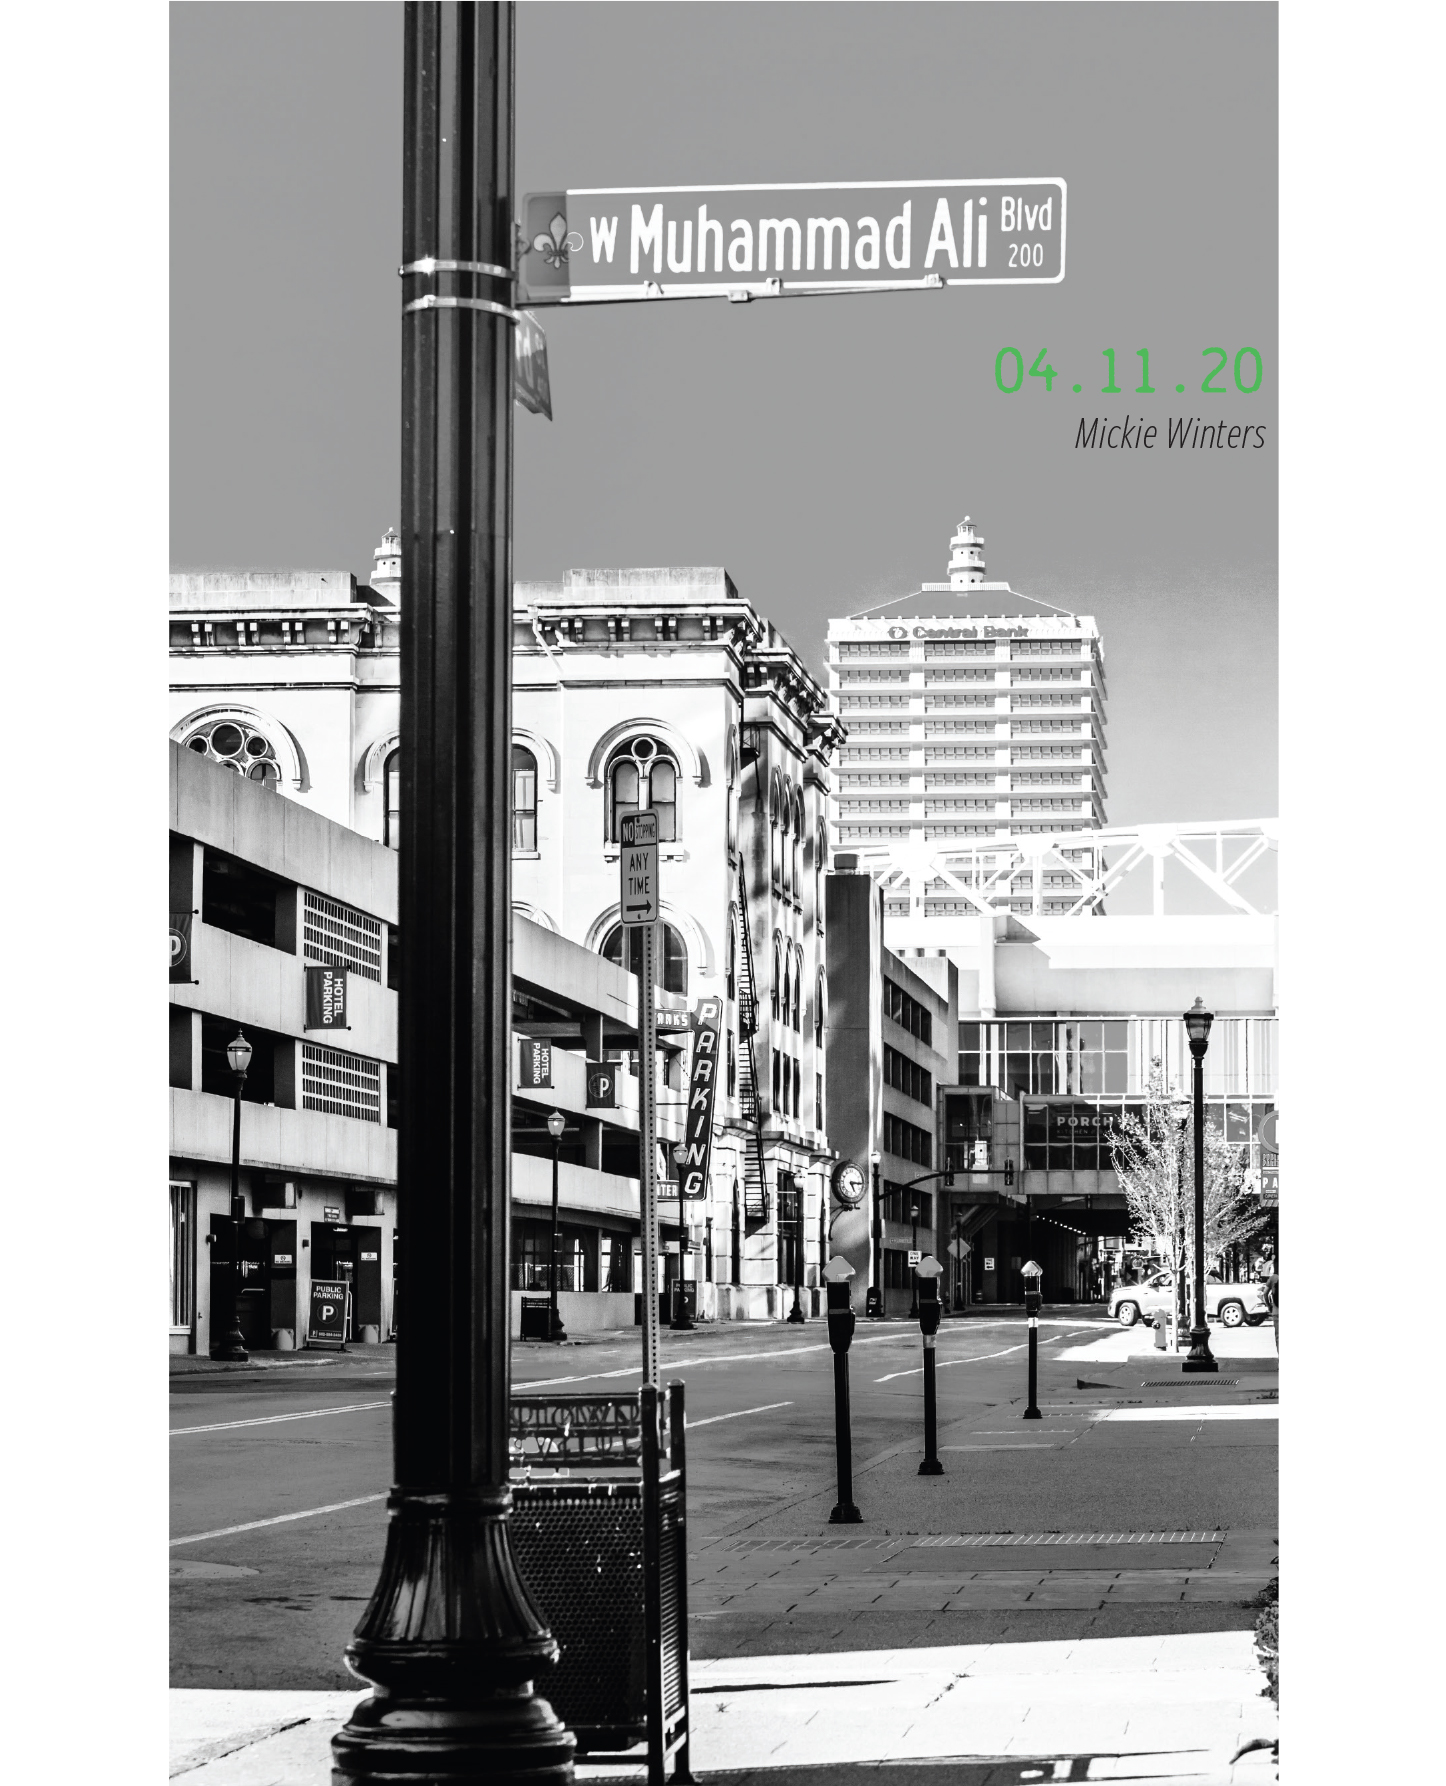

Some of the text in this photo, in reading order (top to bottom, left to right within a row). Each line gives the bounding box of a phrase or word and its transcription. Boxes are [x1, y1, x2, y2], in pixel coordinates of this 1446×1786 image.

[590, 197, 1052, 273] W Muhammad Ali Blvd
[1009, 244, 1043, 268] 200
[912, 626, 1028, 639] Central Bank
[622, 822, 655, 842] NO STOPPING
[630, 852, 649, 872] ANY
[628, 876, 650, 895] TIME
[323, 971, 333, 1024] PARKING
[334, 978, 344, 1016] HOTEL
[655, 1012, 688, 1026] ARKS
[532, 1042, 541, 1085] PARKING
[541, 1048, 550, 1079] HOTEL
[600, 1077, 610, 1098] P
[684, 1002, 718, 1194] PARKING
[1057, 1116, 1113, 1126] PORCH
[313, 1292, 344, 1300] PARKING
[316, 1285, 342, 1293] PUBLIC
[322, 1305, 334, 1320] P
